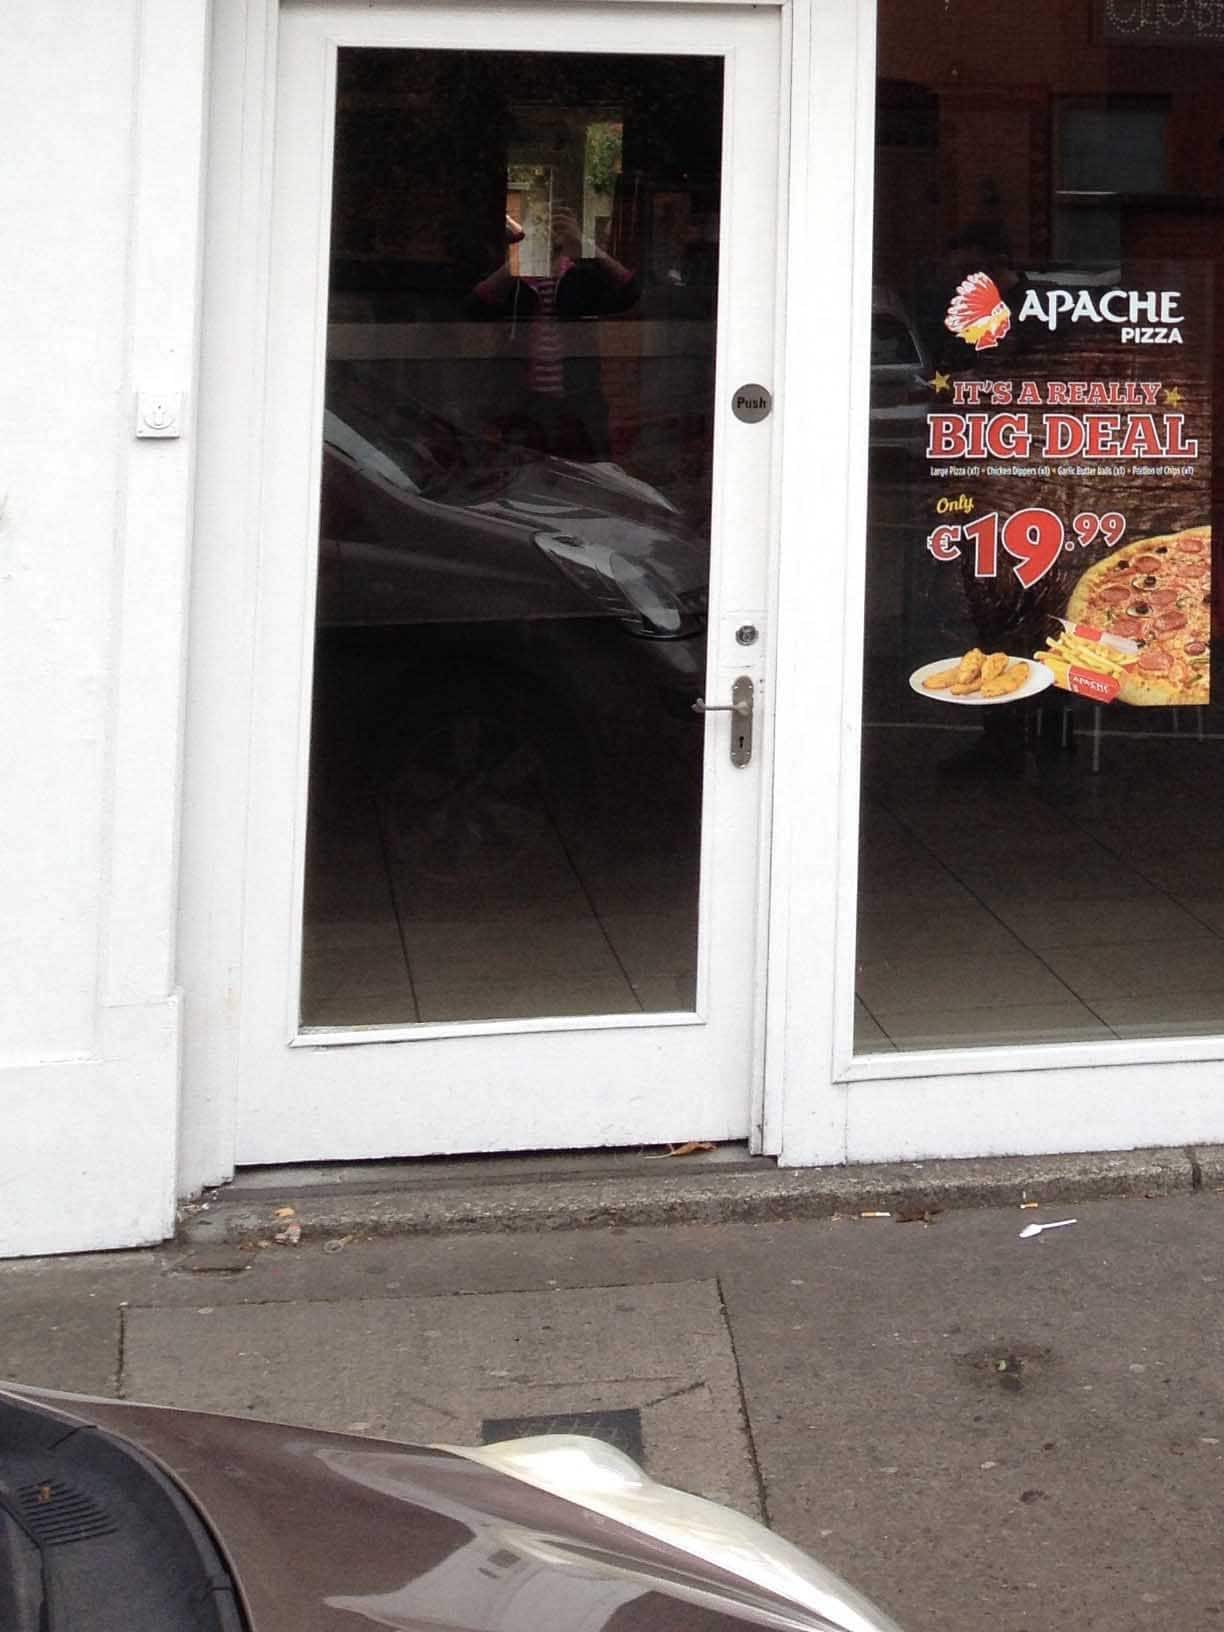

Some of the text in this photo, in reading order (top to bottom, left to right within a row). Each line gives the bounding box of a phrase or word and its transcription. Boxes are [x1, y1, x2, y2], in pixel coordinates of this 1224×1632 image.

[1018, 289, 1185, 331] APACHE
[1121, 327, 1184, 344] PIZZA
[737, 396, 766, 409] Push
[953, 381, 1162, 405] IT'S A REALLY
[926, 414, 1198, 459] BIG DEAL
[936, 495, 974, 513] Only
[927, 508, 1126, 589] €19.99
